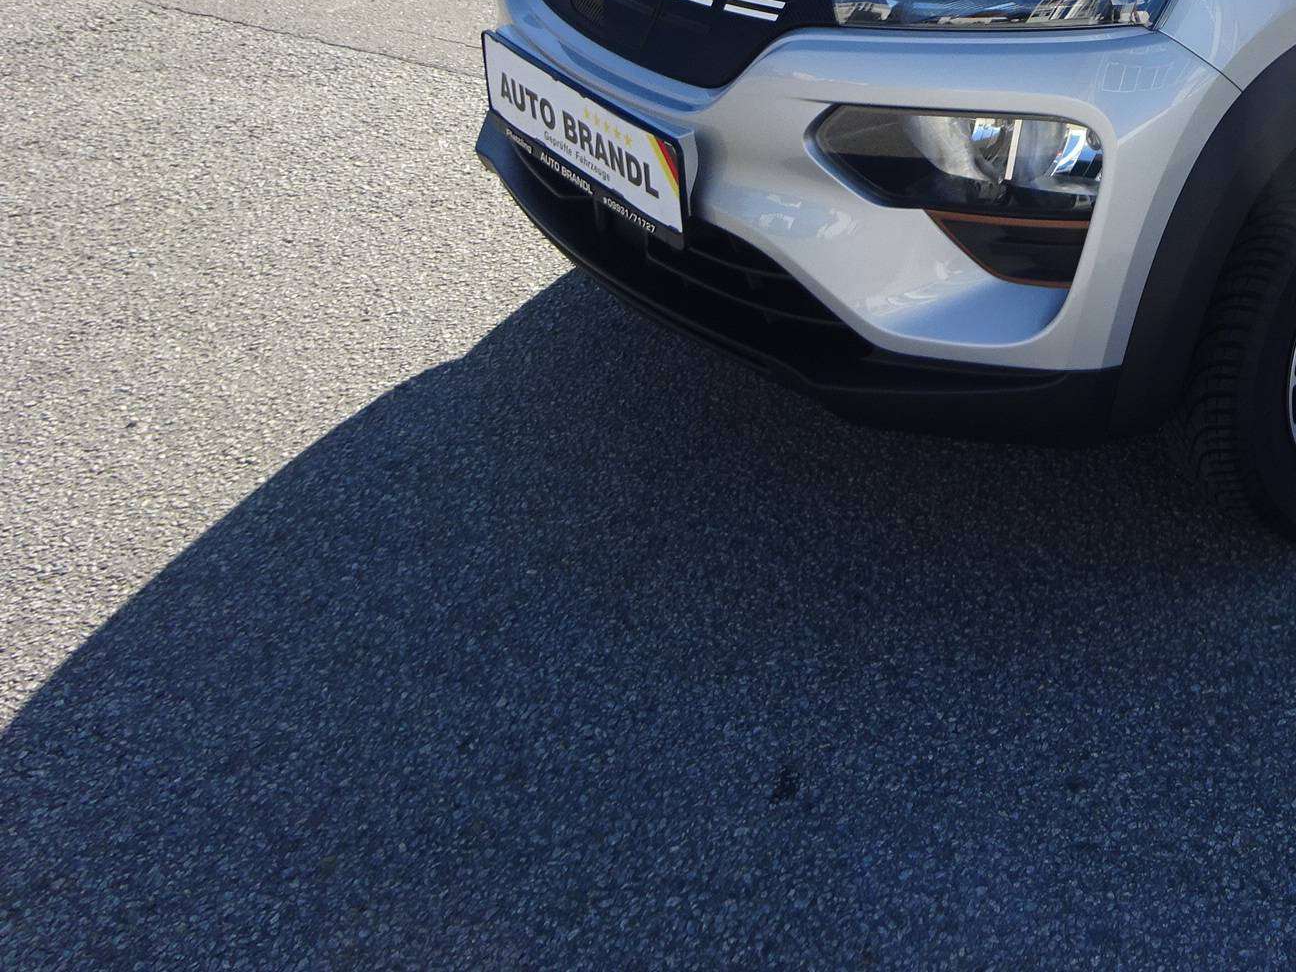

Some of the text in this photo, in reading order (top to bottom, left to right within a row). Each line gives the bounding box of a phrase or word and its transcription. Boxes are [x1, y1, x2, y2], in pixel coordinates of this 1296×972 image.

[501, 72, 660, 199] AUTO BRANDL
[540, 152, 560, 171] AUTO
[561, 167, 593, 195] BRANDL
